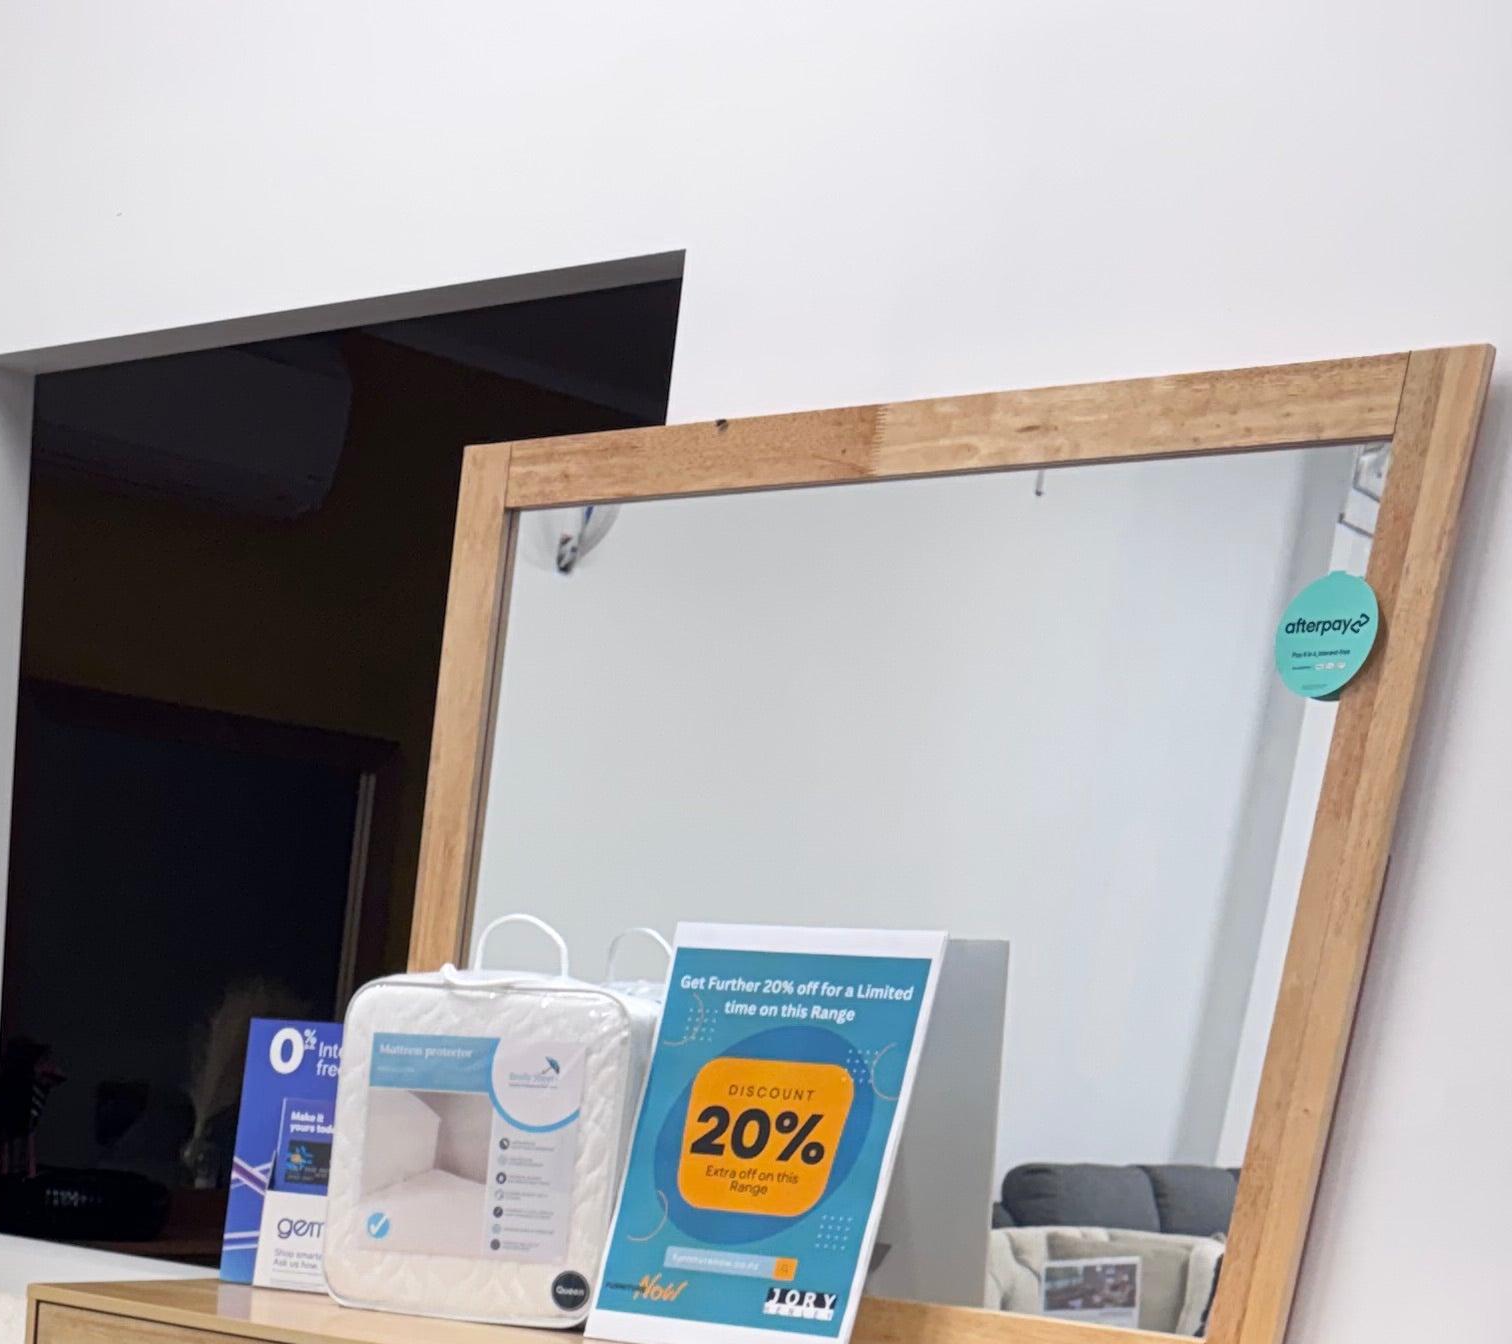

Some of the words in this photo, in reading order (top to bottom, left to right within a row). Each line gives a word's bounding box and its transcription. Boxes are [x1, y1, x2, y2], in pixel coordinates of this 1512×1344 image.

[1285, 617, 1352, 636] afterpay
[681, 975, 705, 989] Get
[708, 976, 760, 993] Further
[763, 979, 793, 994] 20%
[797, 981, 820, 995] off
[821, 982, 843, 997] for
[844, 988, 852, 998] a
[857, 984, 915, 1001] Limited
[724, 1000, 756, 1015] time
[759, 1004, 778, 1017] on
[781, 1003, 808, 1019] this
[810, 1005, 855, 1024] Range
[424, 1047, 473, 1059] protector
[316, 1059, 340, 1077] fre
[728, 1084, 815, 1101] DISCOUNT
[291, 1111, 316, 1122] Make
[690, 1105, 825, 1165] 20%
[705, 1165, 737, 1179] Extra
[739, 1168, 757, 1180] off
[758, 1171, 774, 1181] on
[776, 1172, 799, 1184] this
[729, 1180, 768, 1197] Range
[555, 1285, 585, 1297] Queen
[769, 1288, 836, 1309] JORY
